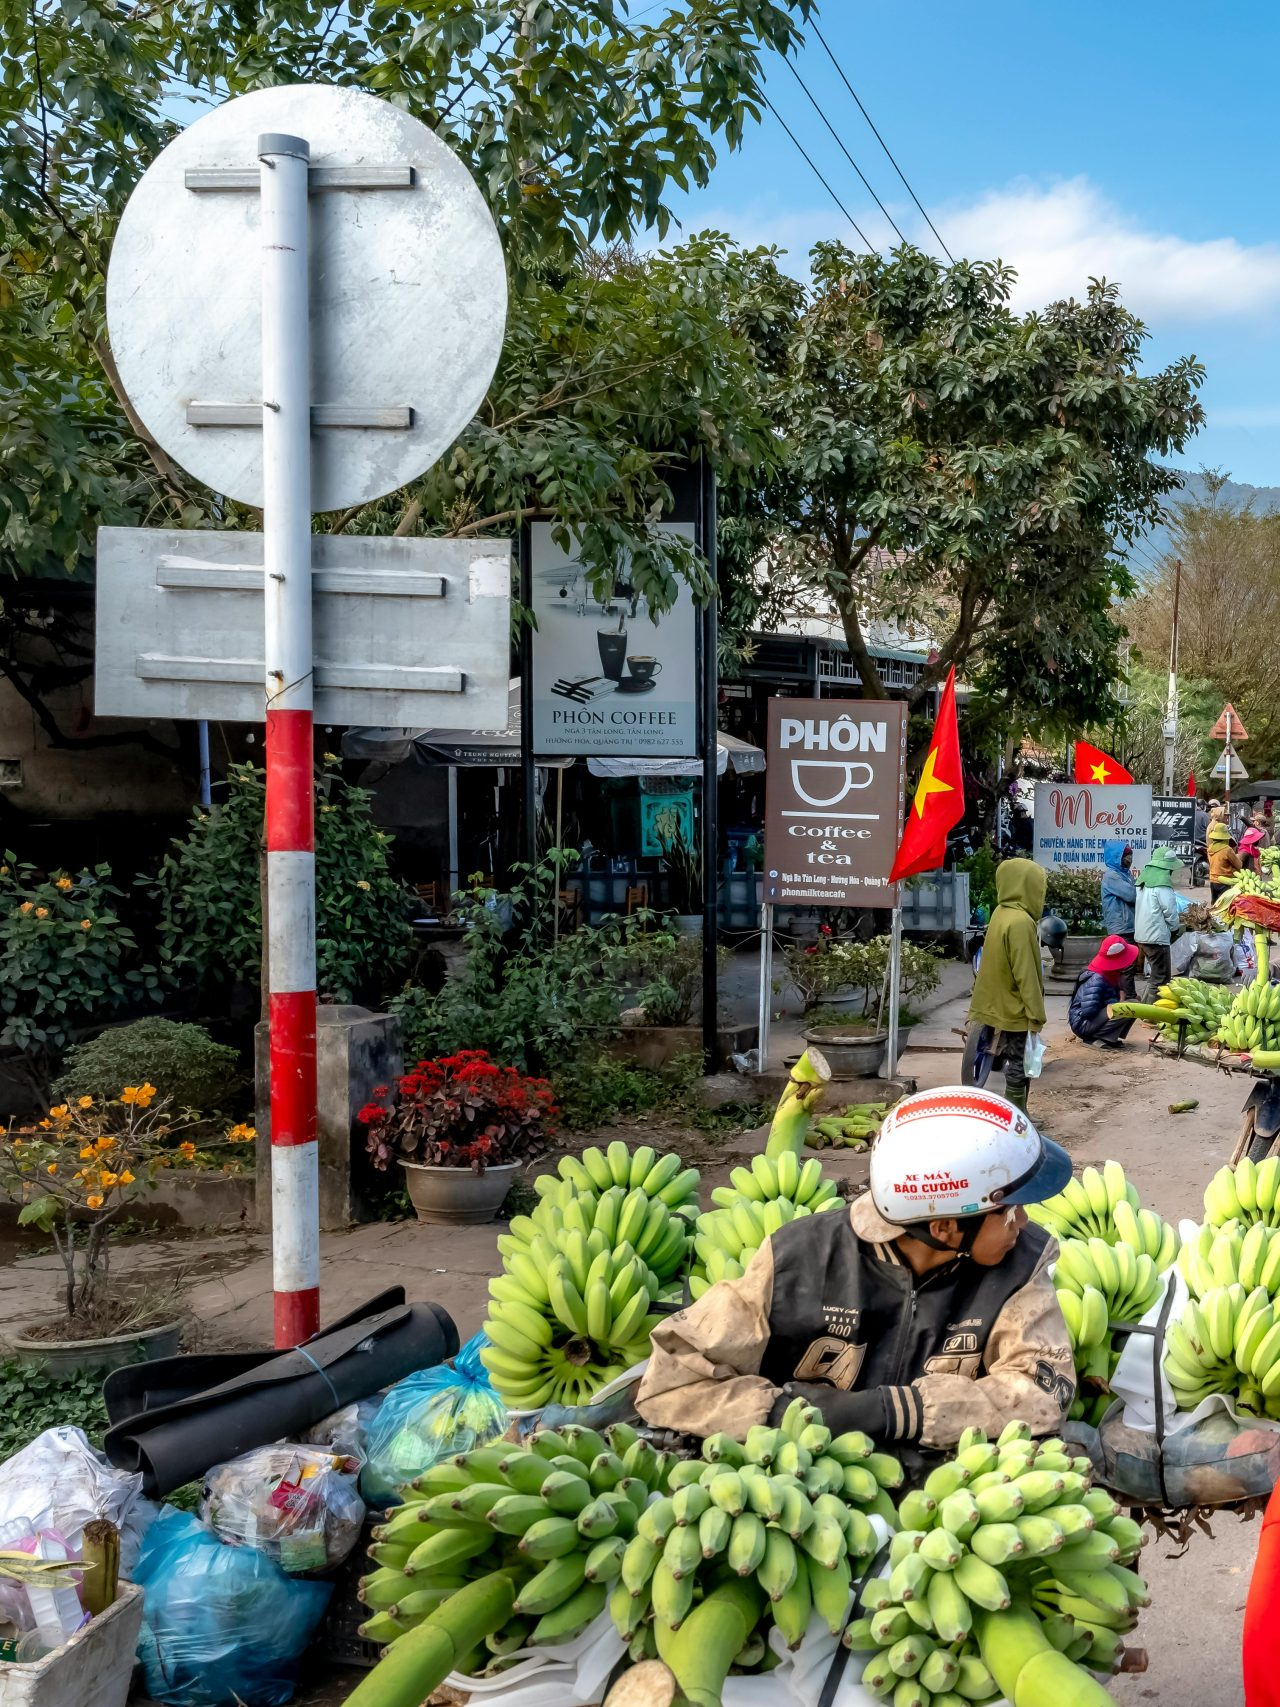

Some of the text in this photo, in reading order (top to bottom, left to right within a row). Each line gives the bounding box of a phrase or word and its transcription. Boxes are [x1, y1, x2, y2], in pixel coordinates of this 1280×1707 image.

[553, 708, 676, 725] PHÔN COFFEE
[780, 714, 887, 752] PHÔN
[1050, 789, 1132, 830] Mai
[788, 825, 872, 839] Coffee
[1115, 827, 1148, 836] STORE
[820, 840, 838, 850] &
[806, 852, 852, 865] tea
[1081, 852, 1095, 863] NAM
[1097, 852, 1105, 863] TR
[813, 874, 826, 885] Long
[782, 887, 846, 898] phonmilkteacafe
[924, 1170, 951, 1180] MÁY
[922, 1178, 969, 1192] CƯỜNG
[823, 1305, 844, 1313] LUCKY
